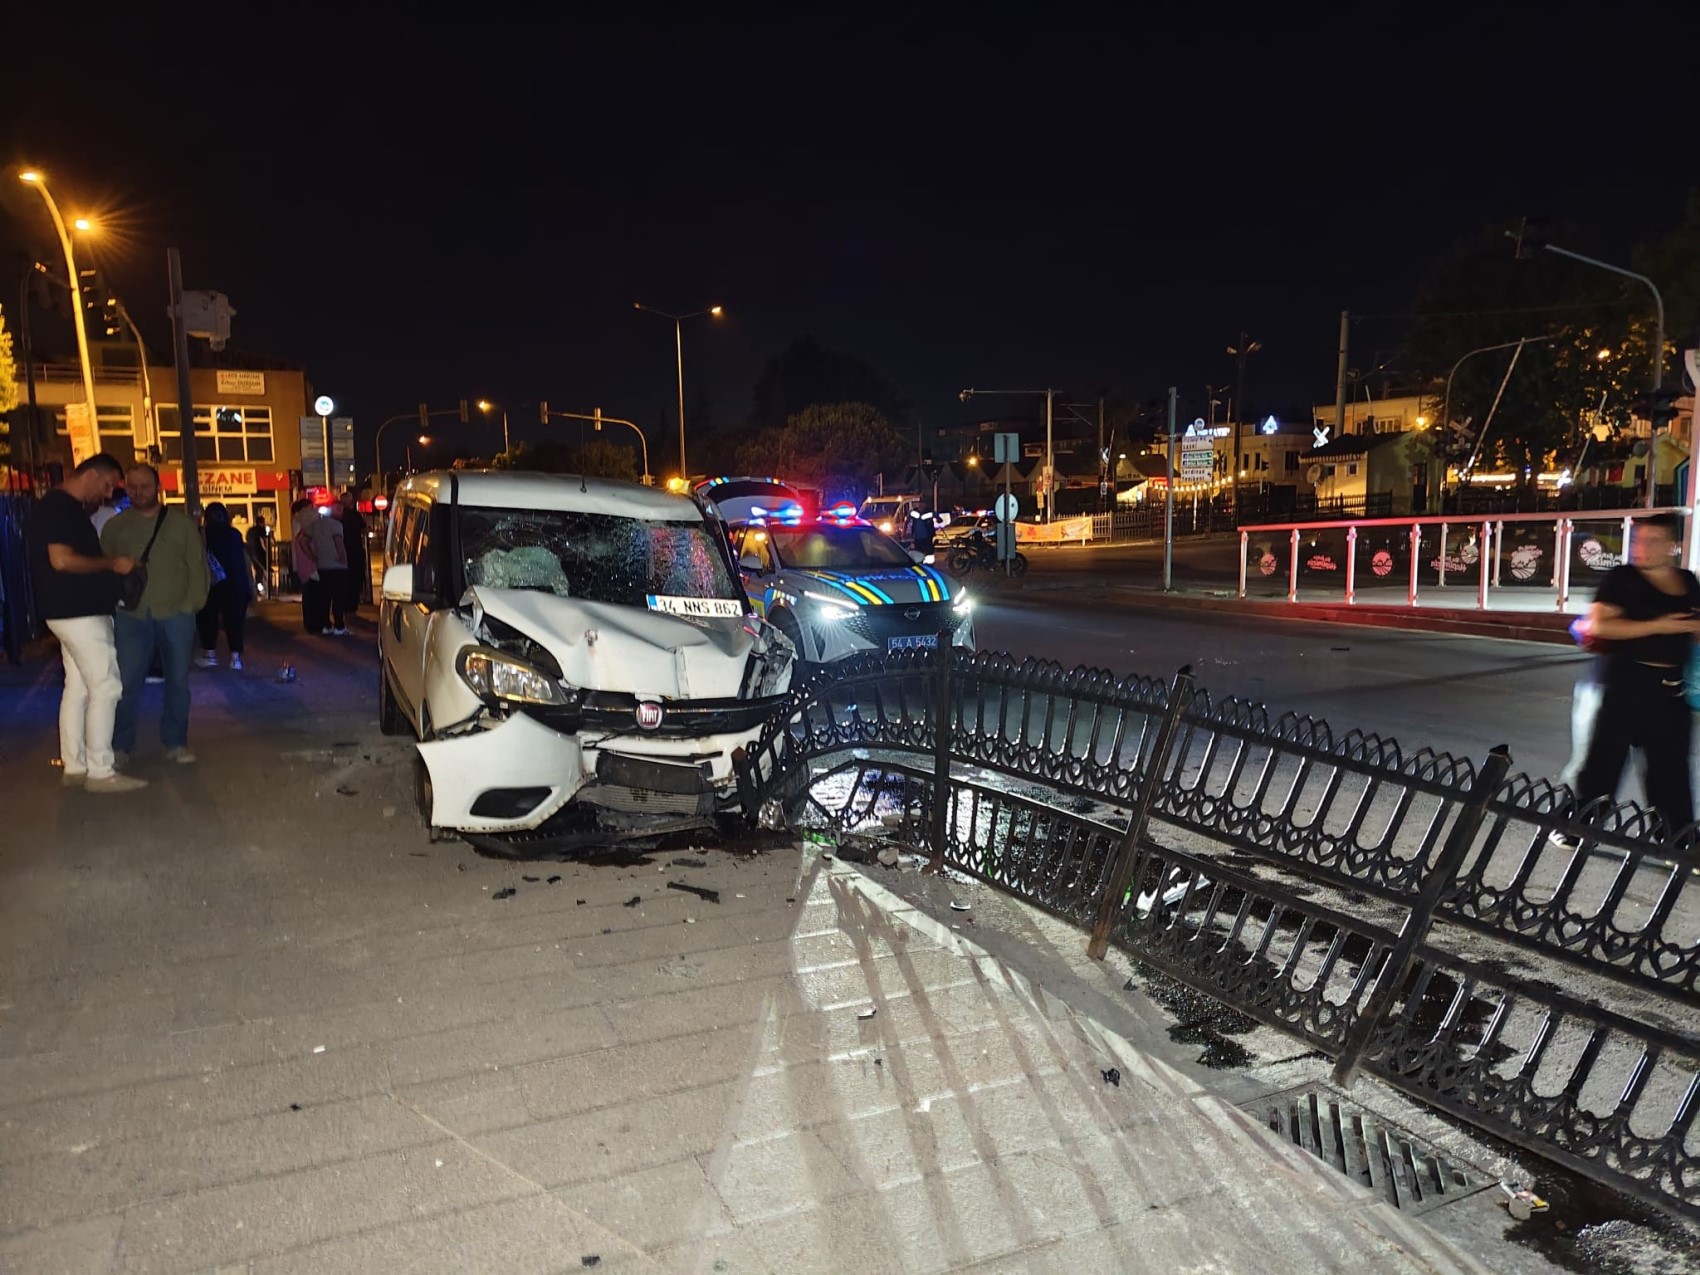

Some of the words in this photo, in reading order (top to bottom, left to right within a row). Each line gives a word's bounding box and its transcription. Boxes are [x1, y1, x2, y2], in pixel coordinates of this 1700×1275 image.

[683, 600, 710, 614] NNS
[714, 602, 740, 616] 862
[891, 639, 903, 649] 54
[906, 638, 913, 648] A
[915, 636, 937, 648] 5432
[641, 709, 658, 723] FIAT
